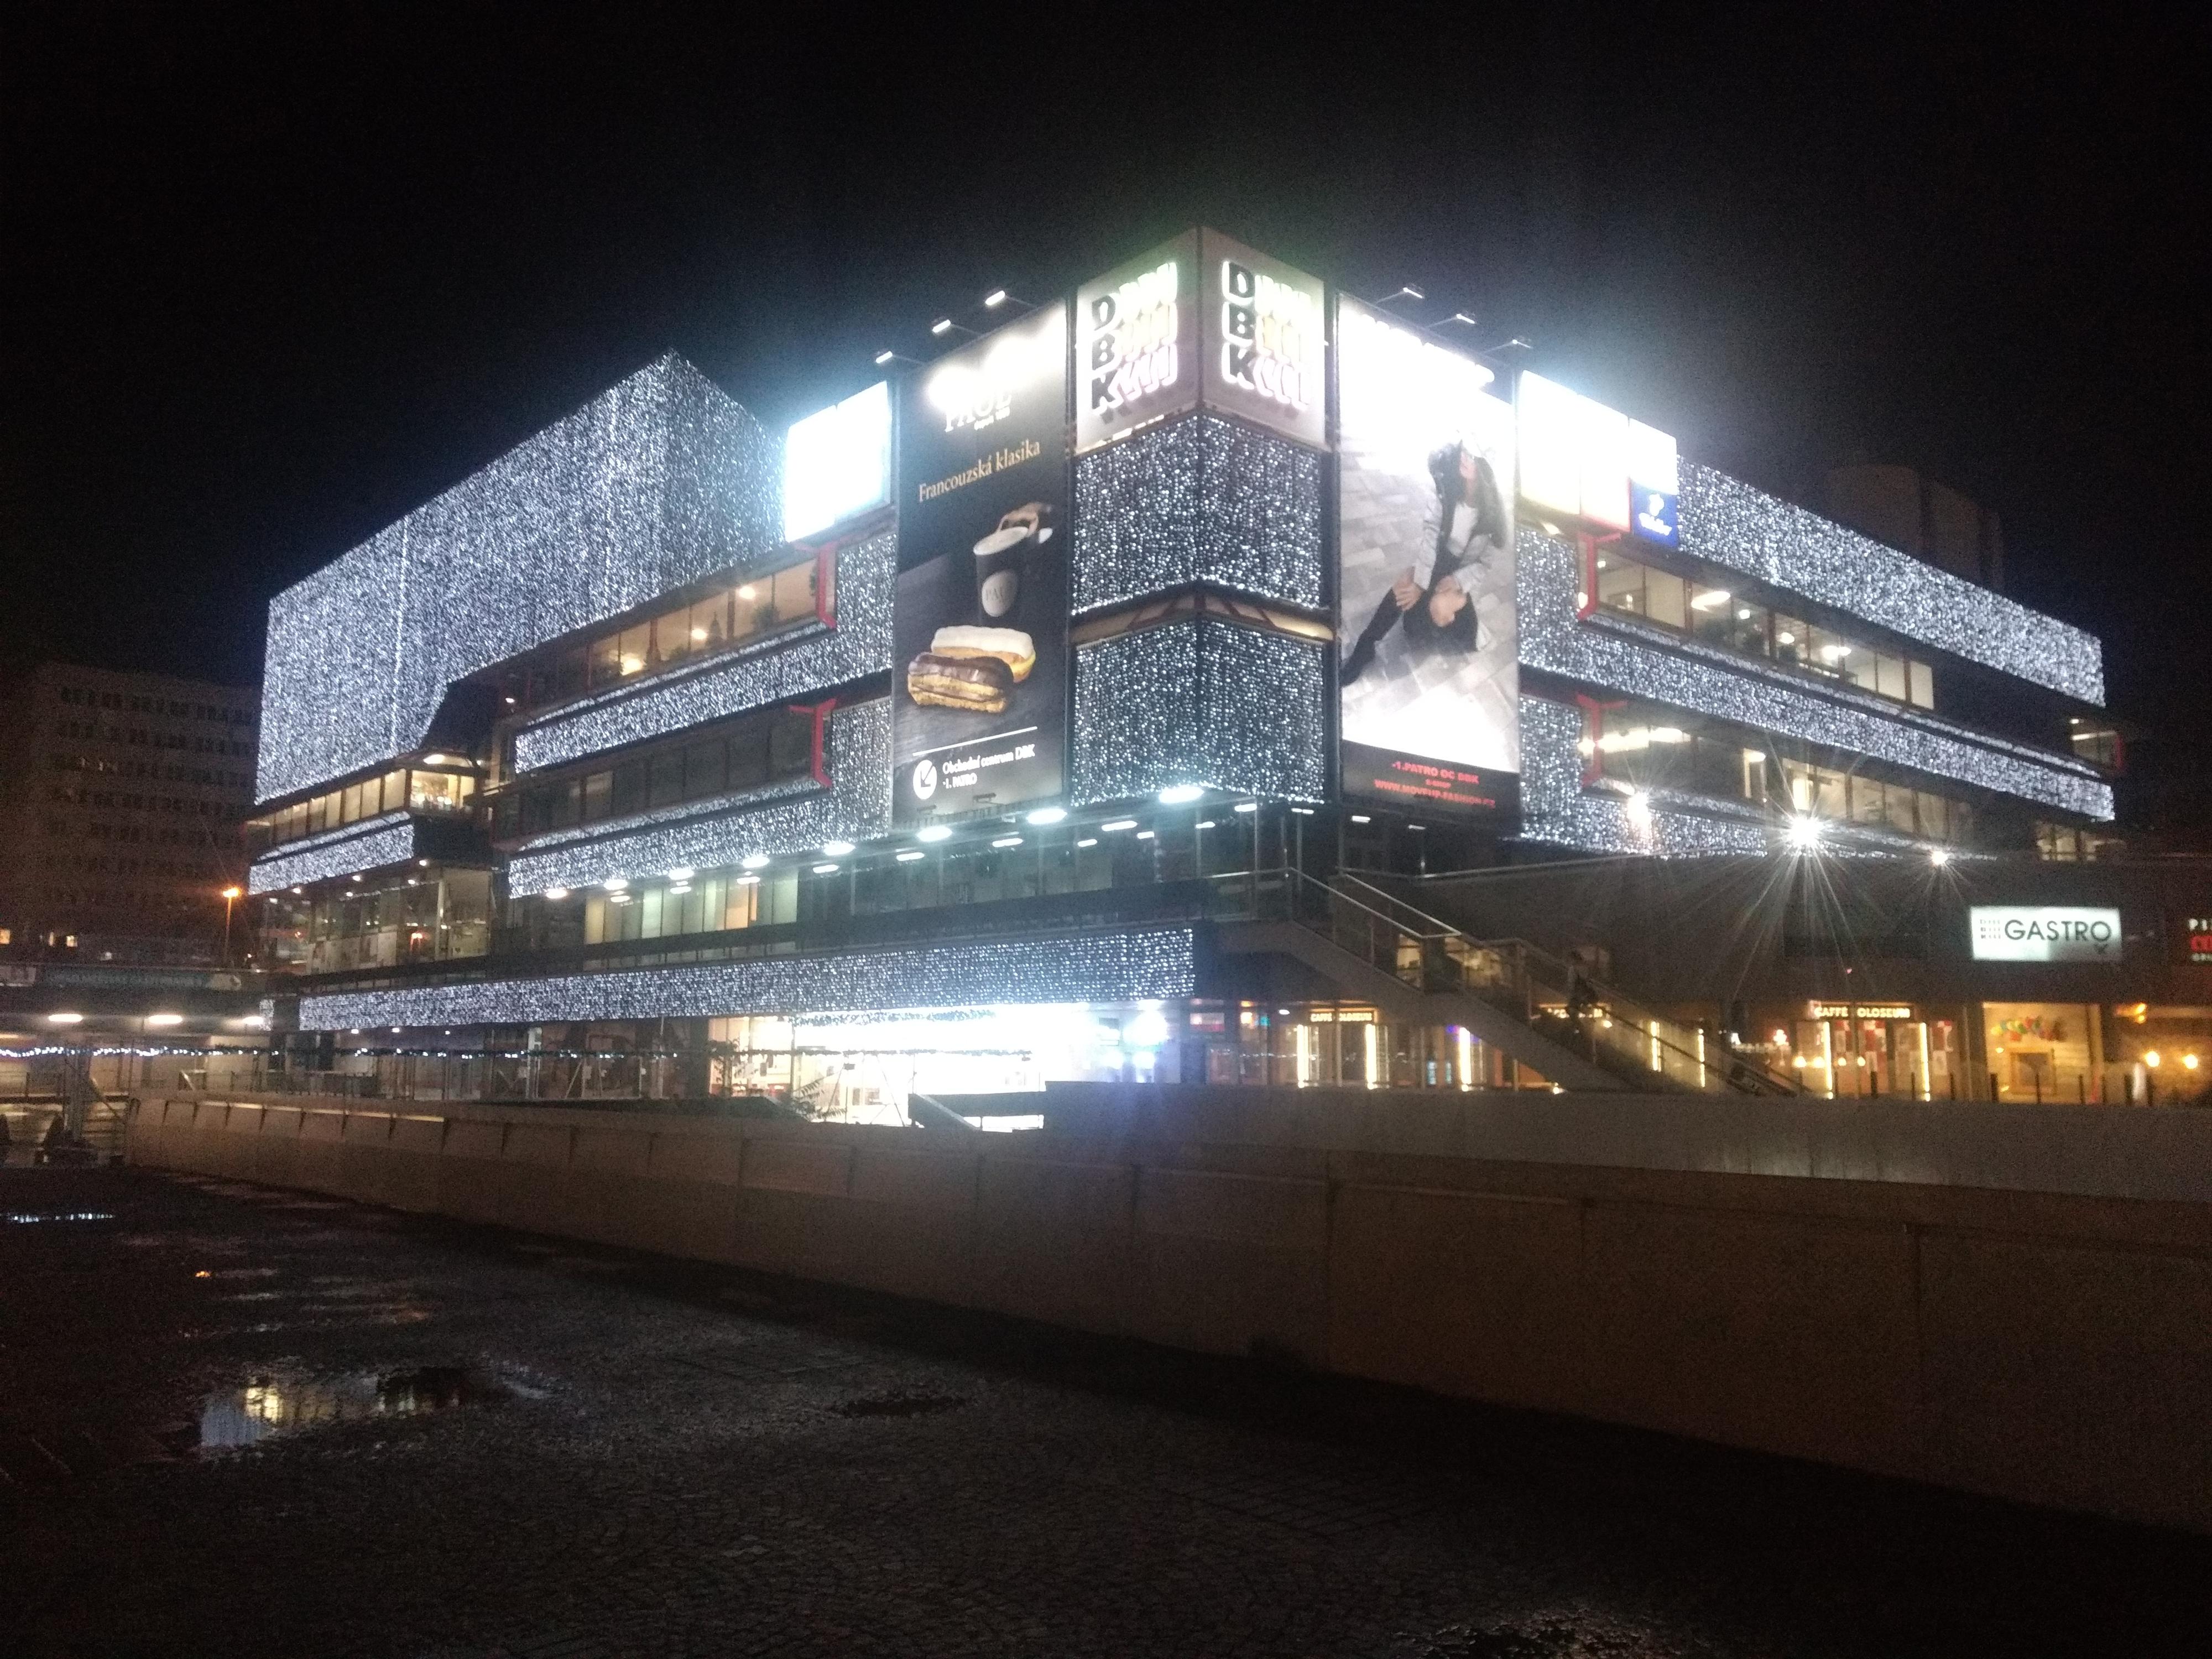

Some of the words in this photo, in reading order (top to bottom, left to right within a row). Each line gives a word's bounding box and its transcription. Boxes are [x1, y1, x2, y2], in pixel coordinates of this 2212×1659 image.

[919, 455, 993, 503] Francouzská
[995, 439, 1041, 472] klasika
[942, 755, 981, 775] Obchodní
[980, 752, 1014, 768] centrum
[2004, 919, 2112, 941] GASTRO
